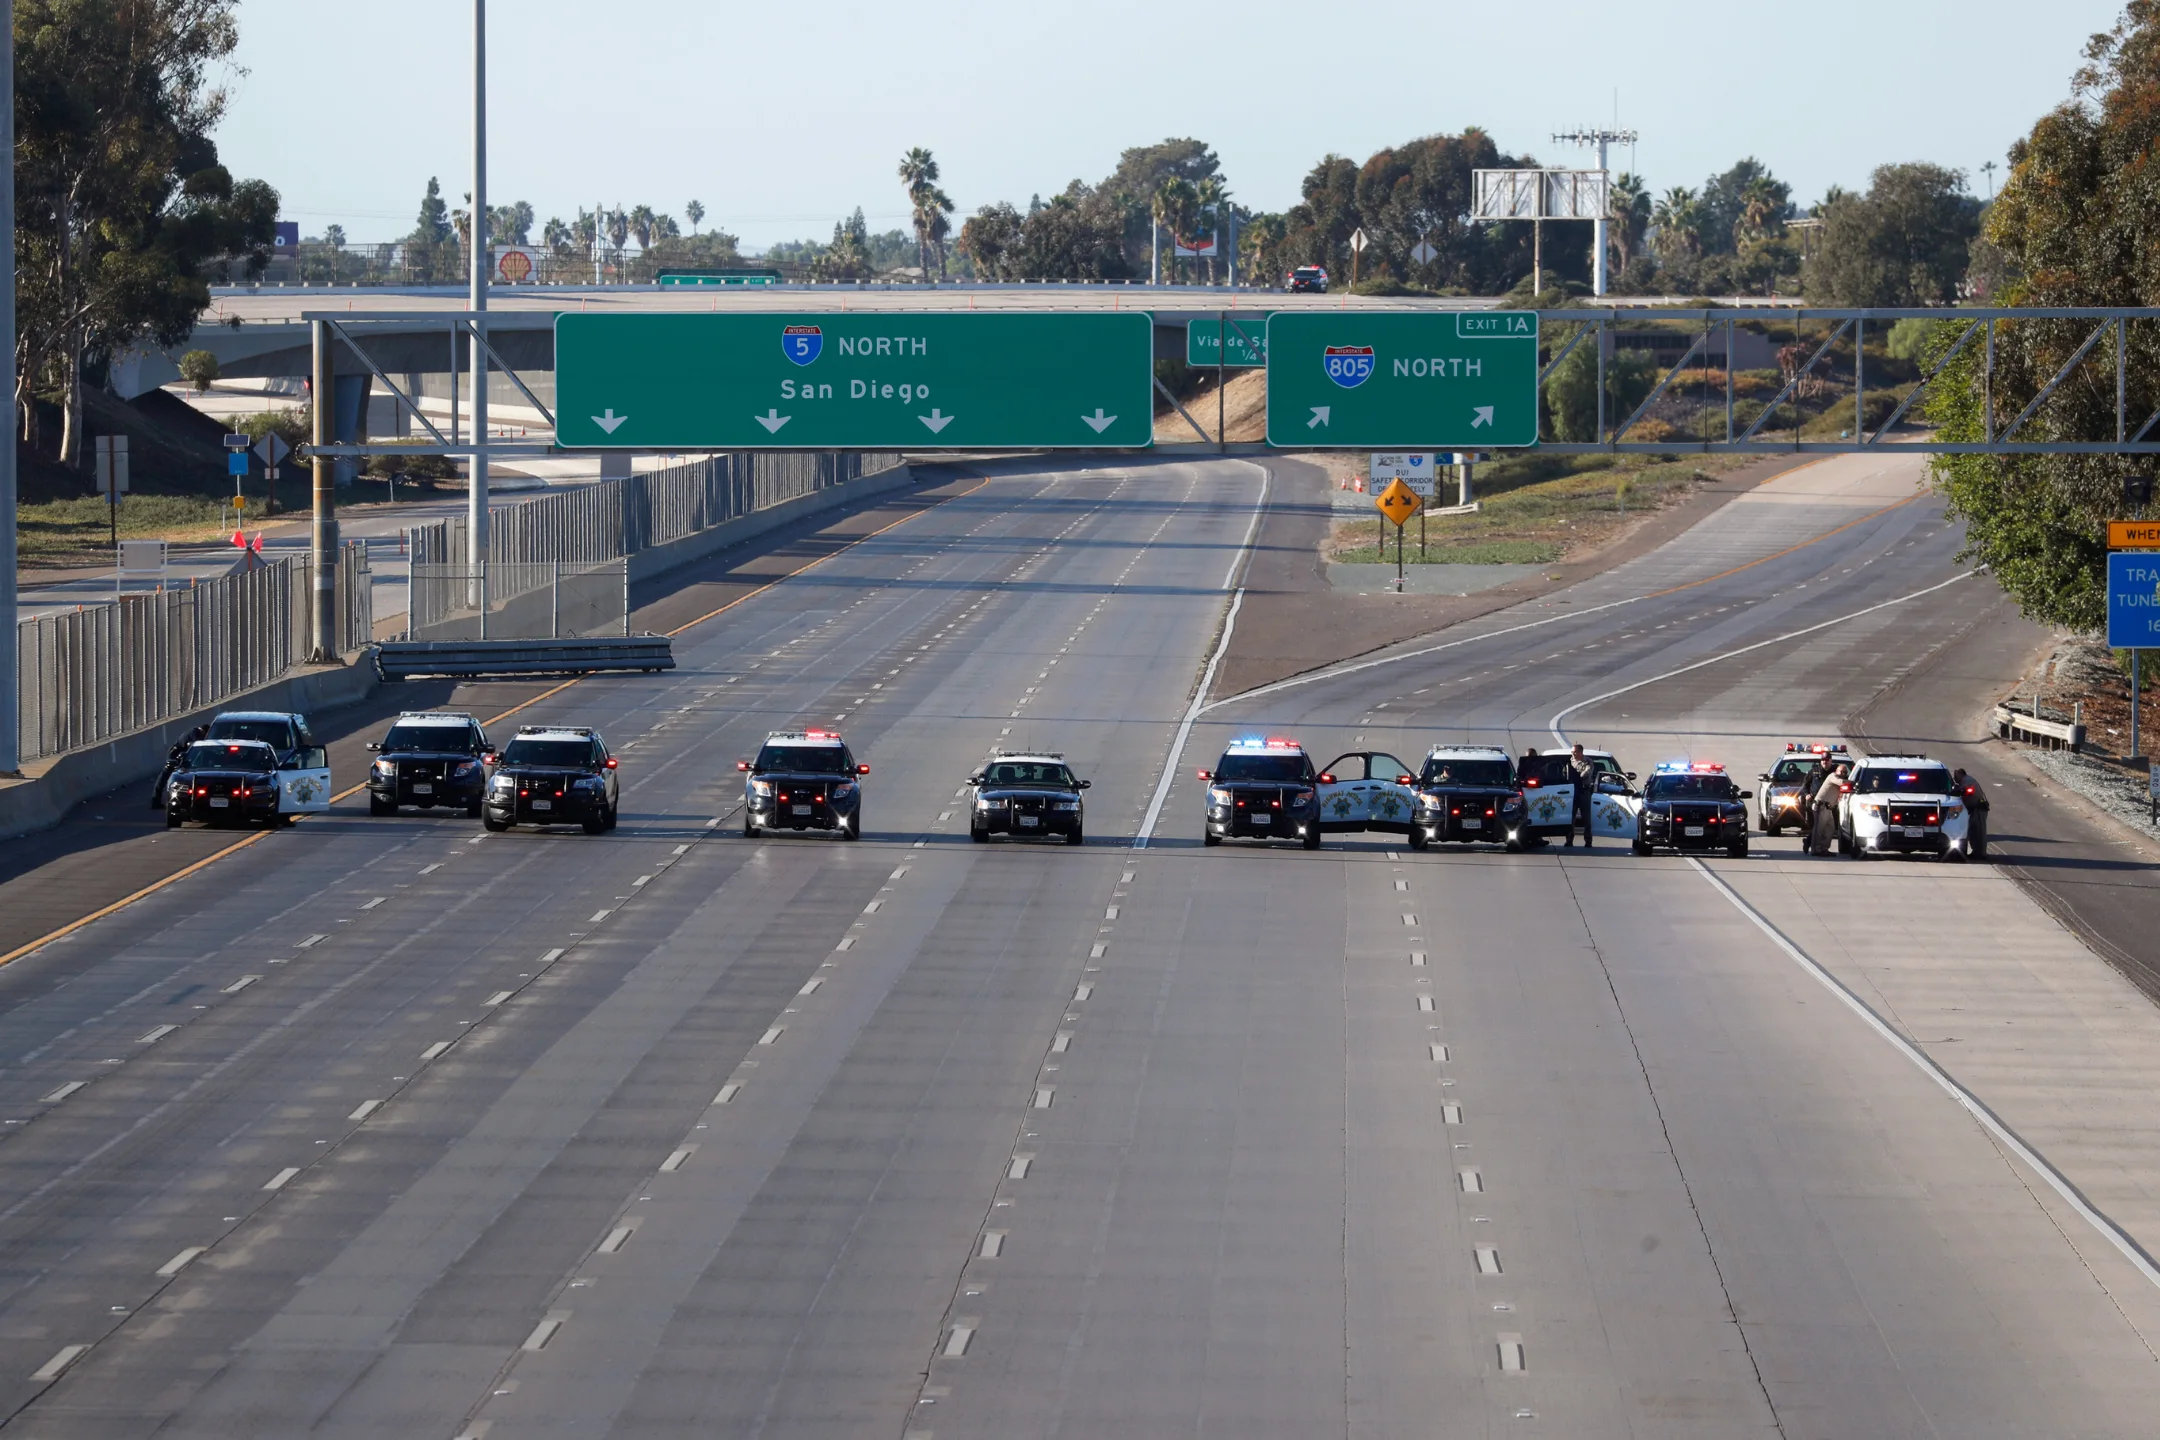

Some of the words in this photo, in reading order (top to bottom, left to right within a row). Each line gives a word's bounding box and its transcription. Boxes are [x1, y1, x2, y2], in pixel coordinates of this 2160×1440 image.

[1466, 319, 1498, 330] EXIT
[1506, 317, 1529, 332] 1A
[796, 337, 809, 356] 5
[839, 337, 927, 356] NORTH
[1197, 336, 1220, 347] Via
[1227, 336, 1244, 347] de
[1329, 358, 1370, 377] 805
[1393, 358, 1482, 377] NORTH
[780, 379, 833, 399] San
[851, 379, 930, 405] Diego
